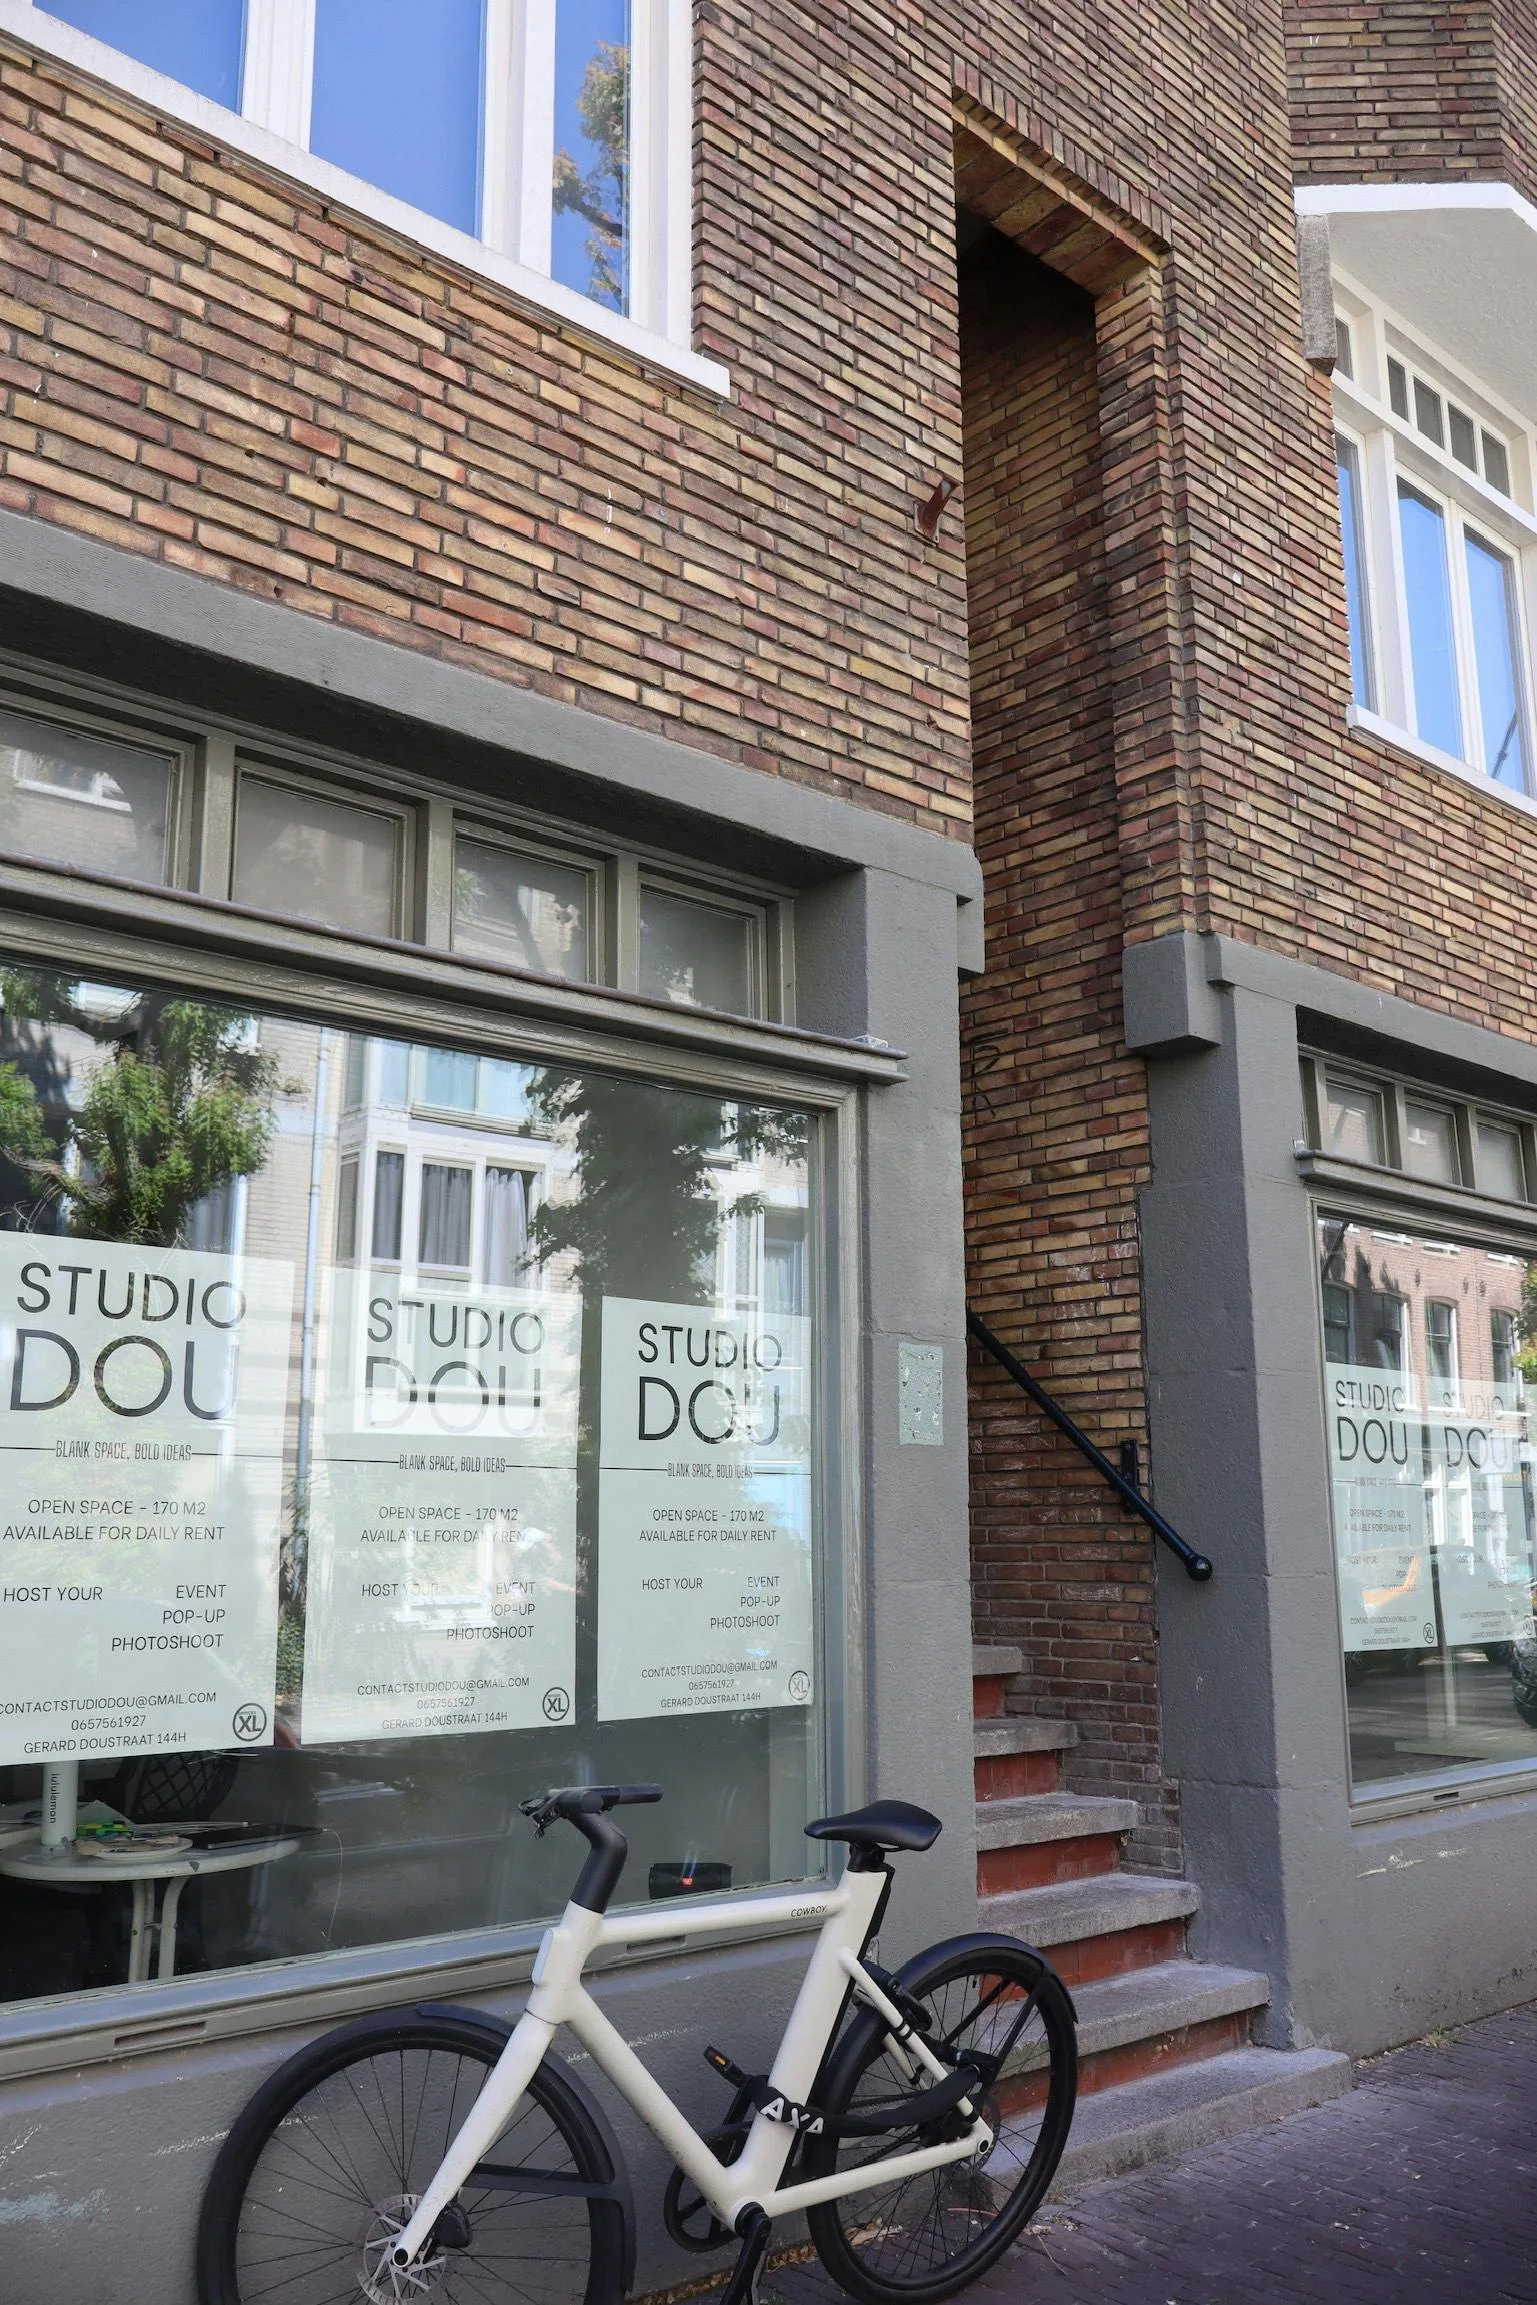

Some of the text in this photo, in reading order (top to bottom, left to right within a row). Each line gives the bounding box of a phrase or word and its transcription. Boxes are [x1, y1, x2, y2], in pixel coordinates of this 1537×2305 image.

[17, 1262, 246, 1329] STUDIO
[368, 1297, 545, 1355] STUDIO
[638, 1323, 782, 1372] STUDIO
[10, 1328, 239, 1420] DOU
[364, 1355, 542, 1436] DOU
[1335, 1380, 1406, 1412] STUDIO
[638, 1376, 780, 1446] DOU
[1337, 1416, 1408, 1465] DOU
[55, 1440, 90, 1459] BLANK
[135, 1443, 160, 1460] BOLD
[163, 1444, 193, 1461] IDEAS
[400, 1454, 426, 1470] BLANK
[461, 1456, 481, 1472] BOLD
[483, 1457, 506, 1473] IDEAS
[668, 1463, 690, 1478] BLANK
[717, 1464, 733, 1478] BOLD
[28, 1499, 75, 1514] OPEN
[80, 1500, 133, 1515] SPACE
[152, 1501, 178, 1515] 170
[183, 1501, 206, 1515] M2
[379, 1506, 415, 1520] OPEN
[418, 1507, 461, 1520] SPACE
[475, 1508, 496, 1521] 170
[500, 1508, 519, 1521] M2
[652, 1509, 682, 1522] OPEN
[685, 1510, 718, 1522] SPACE
[730, 1510, 746, 1522] 170
[750, 1510, 764, 1522] M2
[3, 1525, 225, 1541] AVAILABLE FOR DAILY RENT
[434, 1530, 460, 1543] FOR
[639, 1530, 776, 1541] AVAILABLE FOR DAILY RENT
[362, 1583, 399, 1597] HOST
[496, 1582, 536, 1595] EVENT
[642, 1576, 780, 1590] HOST YOUR EVENT
[3, 1584, 227, 1602] HOST YOUR EVENT
[740, 1596, 781, 1607] POP-UP
[163, 1609, 226, 1624] POP-UP
[710, 1615, 780, 1629] PHOTOSHOOT
[447, 1625, 535, 1640] PHOTOSHOOT
[111, 1634, 224, 1651] PHOTOSHOOT
[547, 1698, 565, 1713] XL
[660, 1692, 761, 1708] GERARD DOUSTRAAT 144H
[71, 1715, 147, 1731] 0657561927
[238, 1715, 261, 1733] XL
[382, 1712, 508, 1730] GERARD DOUSTRAAT 144H
[24, 1732, 187, 1754] GERARD DOUSTRAAT 144H
[50, 1773, 61, 1824] lululemon
